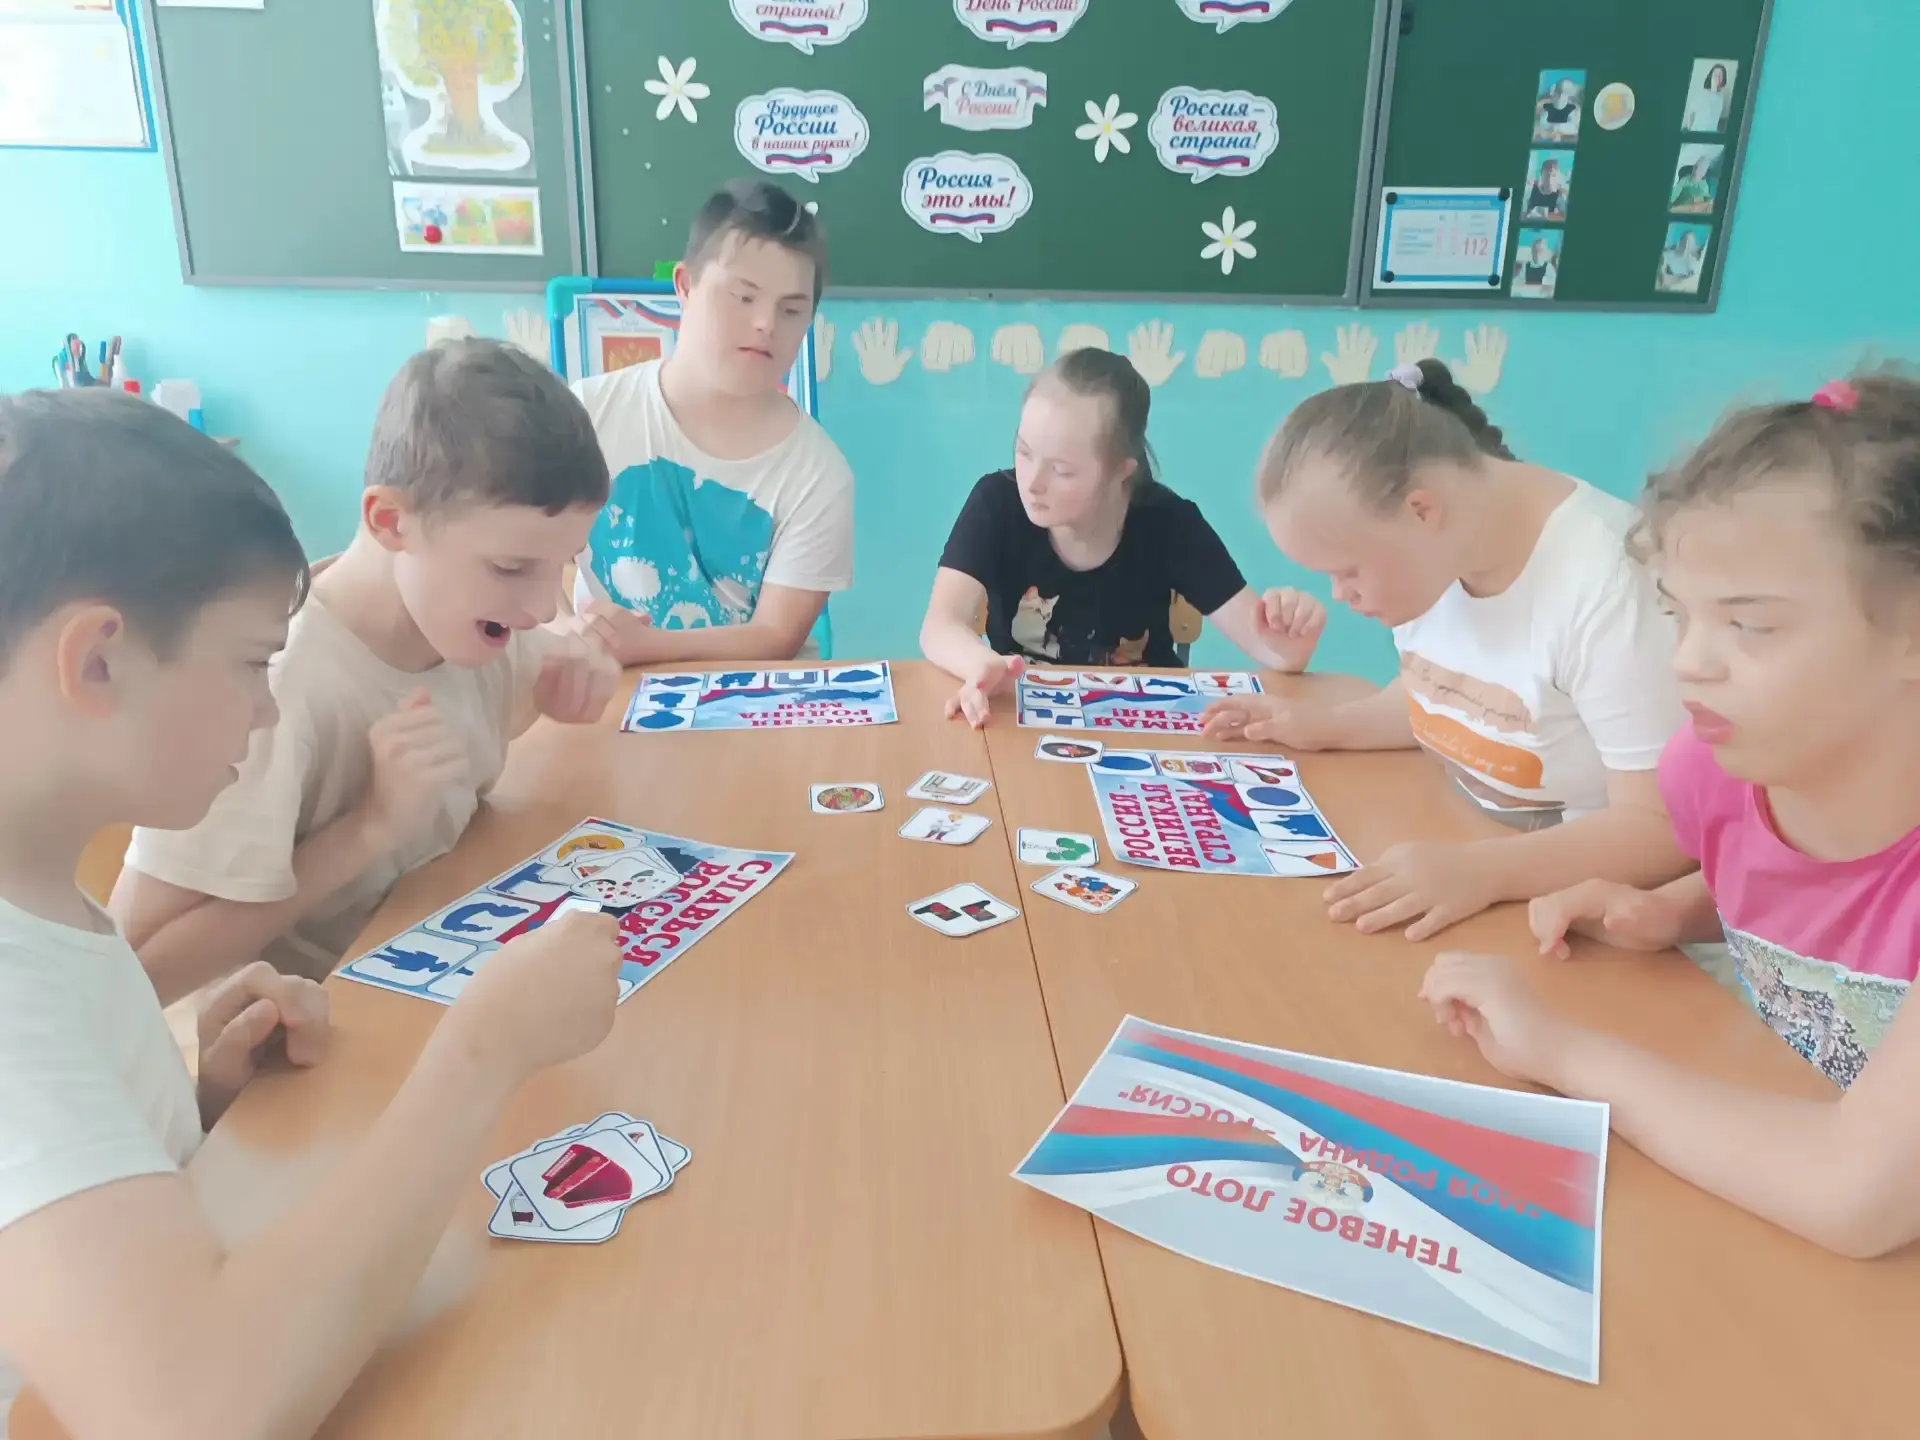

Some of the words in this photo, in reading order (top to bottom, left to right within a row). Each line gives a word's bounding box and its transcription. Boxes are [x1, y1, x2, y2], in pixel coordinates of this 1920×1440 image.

[756, 2, 845, 21] страной!
[766, 99, 839, 118] Будущее
[956, 96, 1020, 115] России!
[1170, 95, 1250, 117] Россия
[754, 114, 837, 136] России
[1172, 114, 1258, 133] великая
[751, 136, 760, 149] в
[763, 139, 808, 150] наших
[810, 131, 859, 154] руках!
[1169, 131, 1261, 153] страна!
[917, 166, 994, 190] Россия
[921, 194, 964, 208] это
[968, 185, 1016, 208] мы!
[1464, 237, 1489, 256] 112
[739, 708, 869, 719] РОДИНА
[778, 702, 843, 710] МОЯ
[752, 717, 873, 727] РОССИЯ
[1108, 792, 1160, 861] РОССИЯ
[1140, 783, 1201, 868] ВЕЛИКАЯ
[1175, 787, 1237, 864] СТРАНА!
[617, 860, 731, 947] РОССИ
[623, 859, 773, 967] СЛАВЬСЯ
[1299, 1131, 1440, 1189] РОДИНА
[1166, 1163, 1276, 1213] ЛОТО
[1284, 1199, 1463, 1275] ТЕНЕВОЕ
